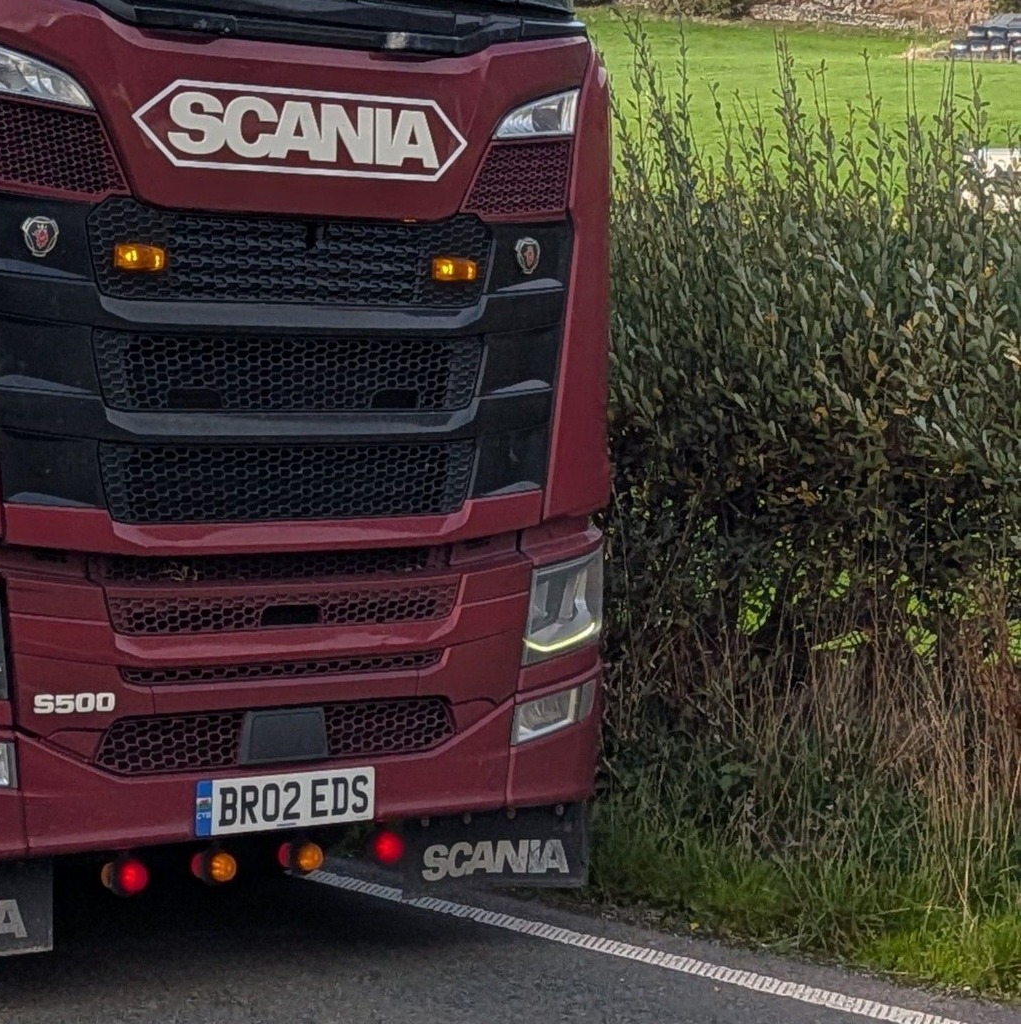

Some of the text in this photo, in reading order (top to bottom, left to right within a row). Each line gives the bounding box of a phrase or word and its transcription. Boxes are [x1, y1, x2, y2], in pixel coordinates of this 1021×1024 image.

[167, 91, 440, 169] SCANIA
[33, 692, 116, 714] S500
[218, 775, 369, 827] BR02 EDS
[421, 839, 570, 882] SCANIA
